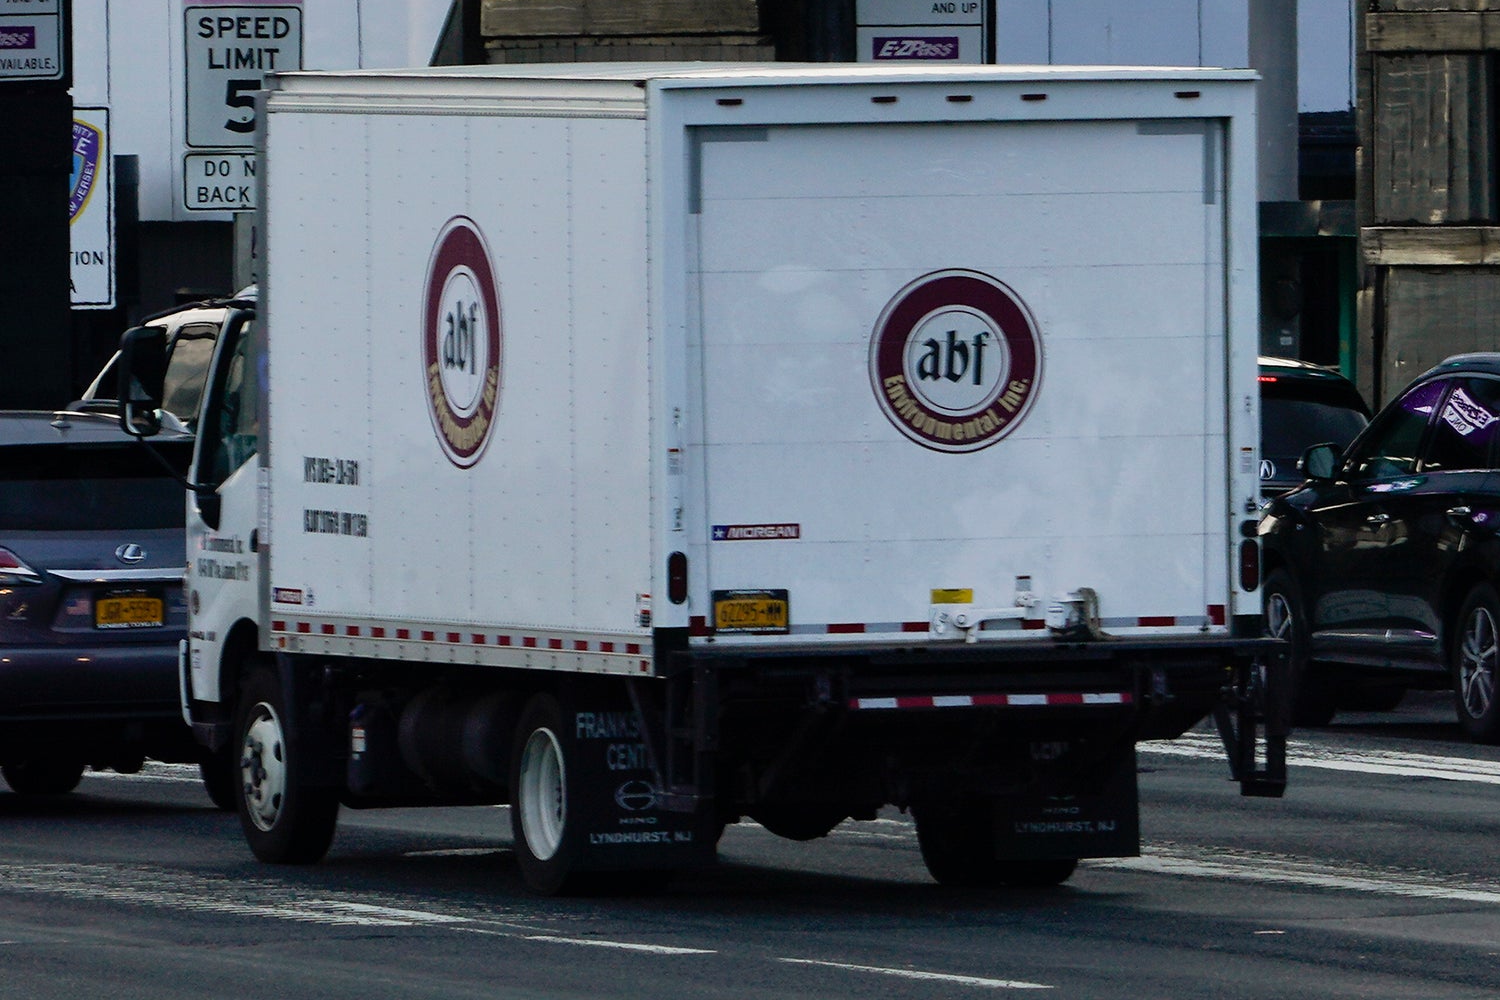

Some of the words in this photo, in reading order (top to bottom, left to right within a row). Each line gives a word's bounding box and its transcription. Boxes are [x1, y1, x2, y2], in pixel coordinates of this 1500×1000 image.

[931, 3, 956, 14] AND
[961, 3, 978, 13] UP
[197, 17, 290, 39] SPEED
[0, 58, 56, 70] VAILABLE.
[208, 48, 280, 71] LIMIT
[224, 79, 262, 134] 5
[204, 160, 230, 177] DO
[77, 160, 96, 201] JERSEY
[197, 186, 251, 203] BACK
[443, 300, 478, 375] abf
[917, 330, 989, 385] abf
[997, 378, 1030, 413] Inc.
[727, 525, 796, 539] MORGAN
[1097, 820, 1117, 832] NJ
[674, 830, 692, 842] NJ
